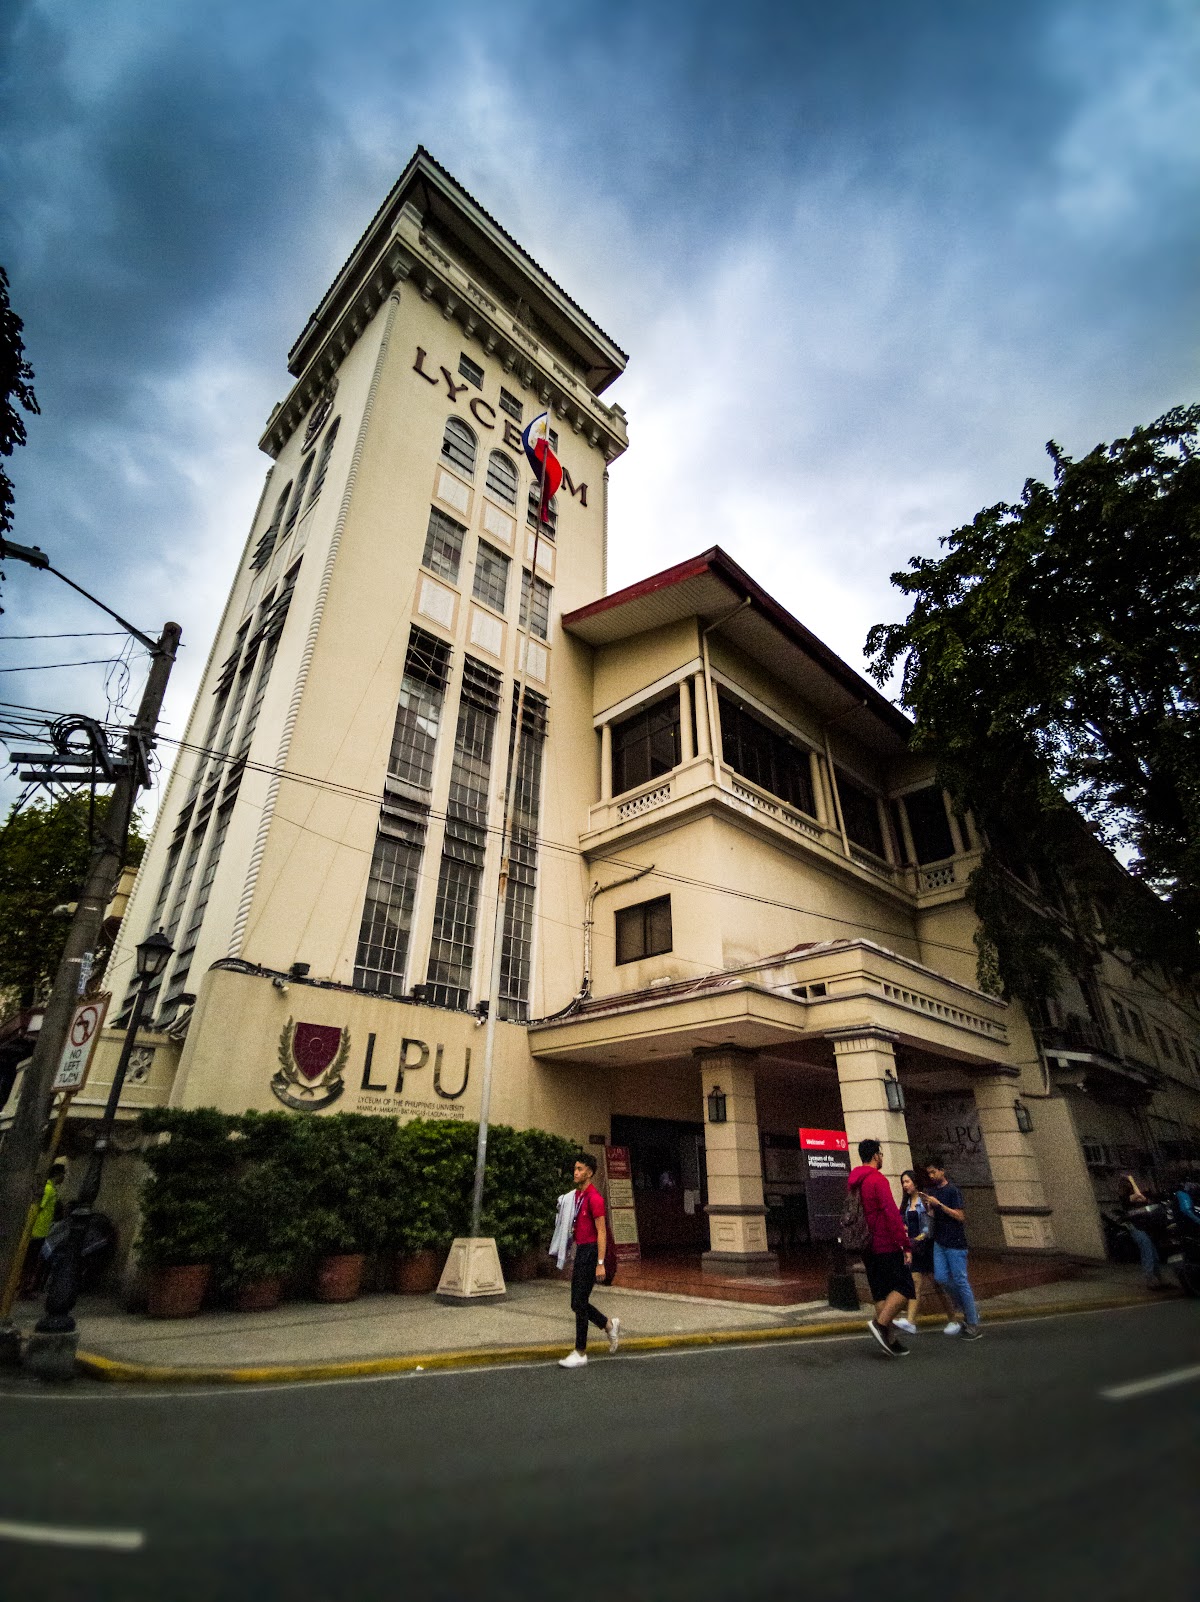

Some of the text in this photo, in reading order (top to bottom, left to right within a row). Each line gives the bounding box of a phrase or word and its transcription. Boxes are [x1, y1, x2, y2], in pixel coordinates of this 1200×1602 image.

[412, 346, 588, 507] LYCEM
[69, 1049, 81, 1059] NO
[64, 1061, 81, 1072] LEFT
[360, 1033, 472, 1100] LPU
[59, 1073, 78, 1083] TURN
[358, 1096, 465, 1112] LYCEUM OF THE PHILIPPINES UNIVERSITY
[945, 1125, 982, 1143] LPU
